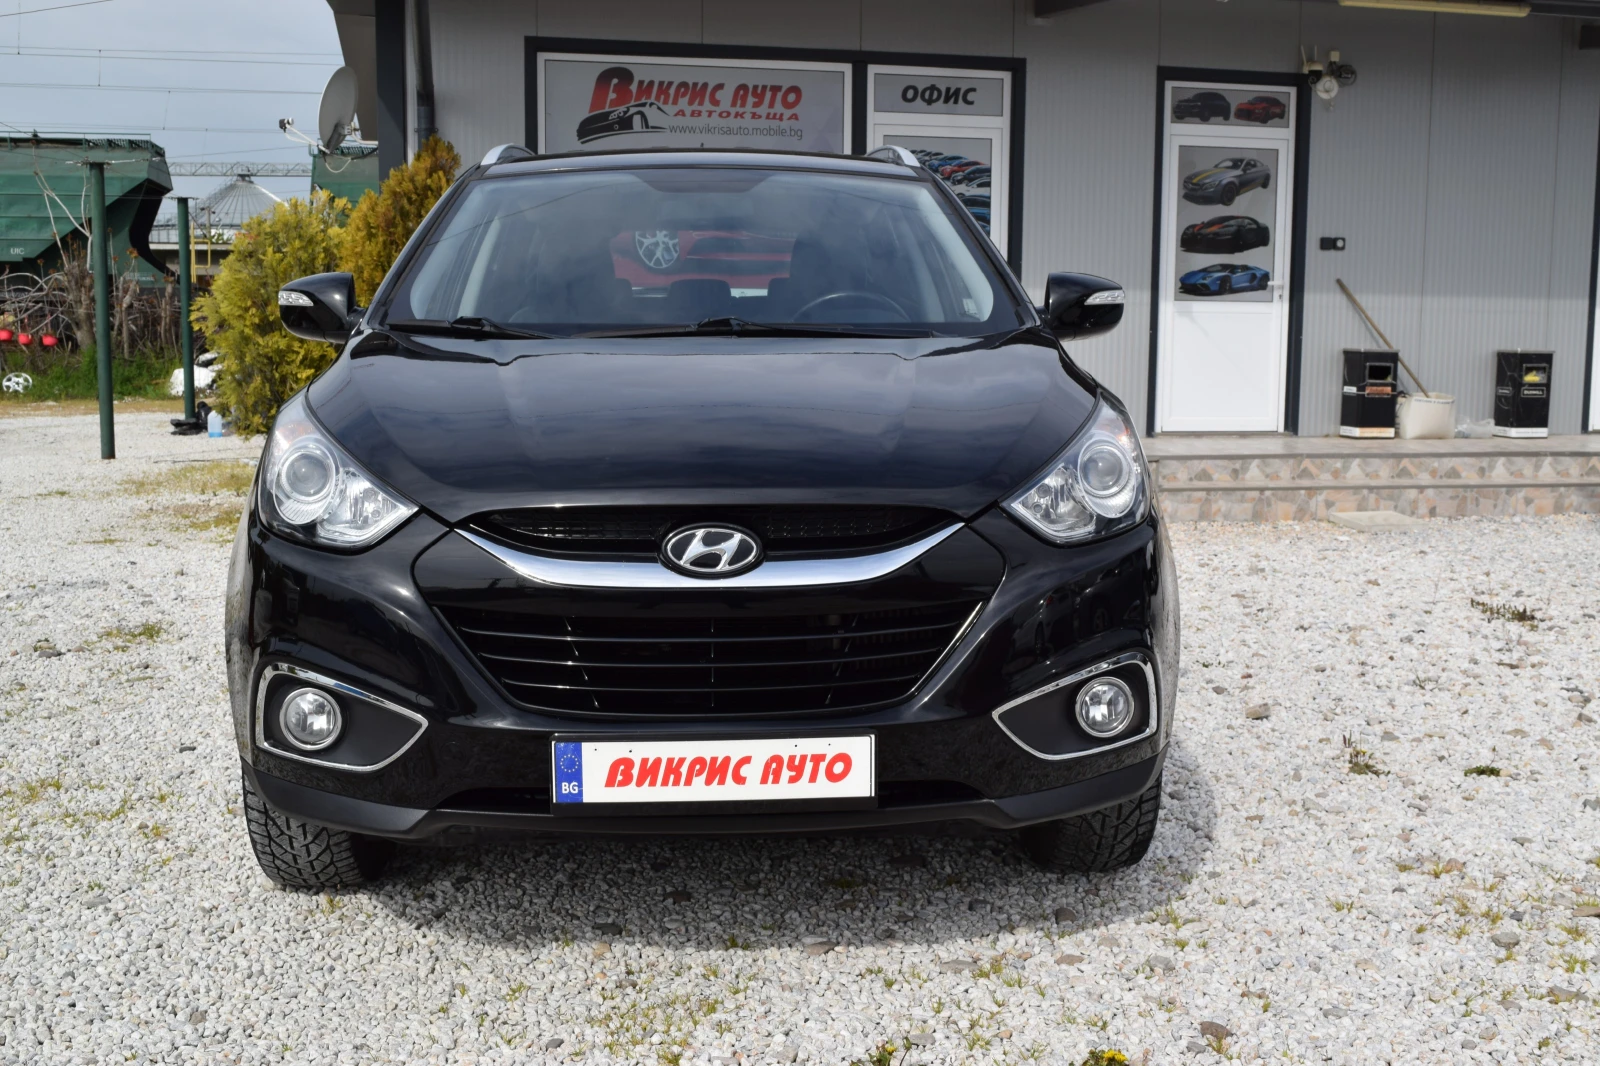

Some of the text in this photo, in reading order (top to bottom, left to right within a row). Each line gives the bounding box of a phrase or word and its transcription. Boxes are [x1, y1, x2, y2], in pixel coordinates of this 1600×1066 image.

[730, 83, 803, 110] АУТО
[901, 84, 977, 106] ОФИС
[673, 108, 800, 121] АВТОКЪЩА
[668, 123, 803, 140] www.vikrisauto.mobile.bg
[604, 752, 853, 788] ВИКРИС АУТО
[561, 781, 579, 794] BG
